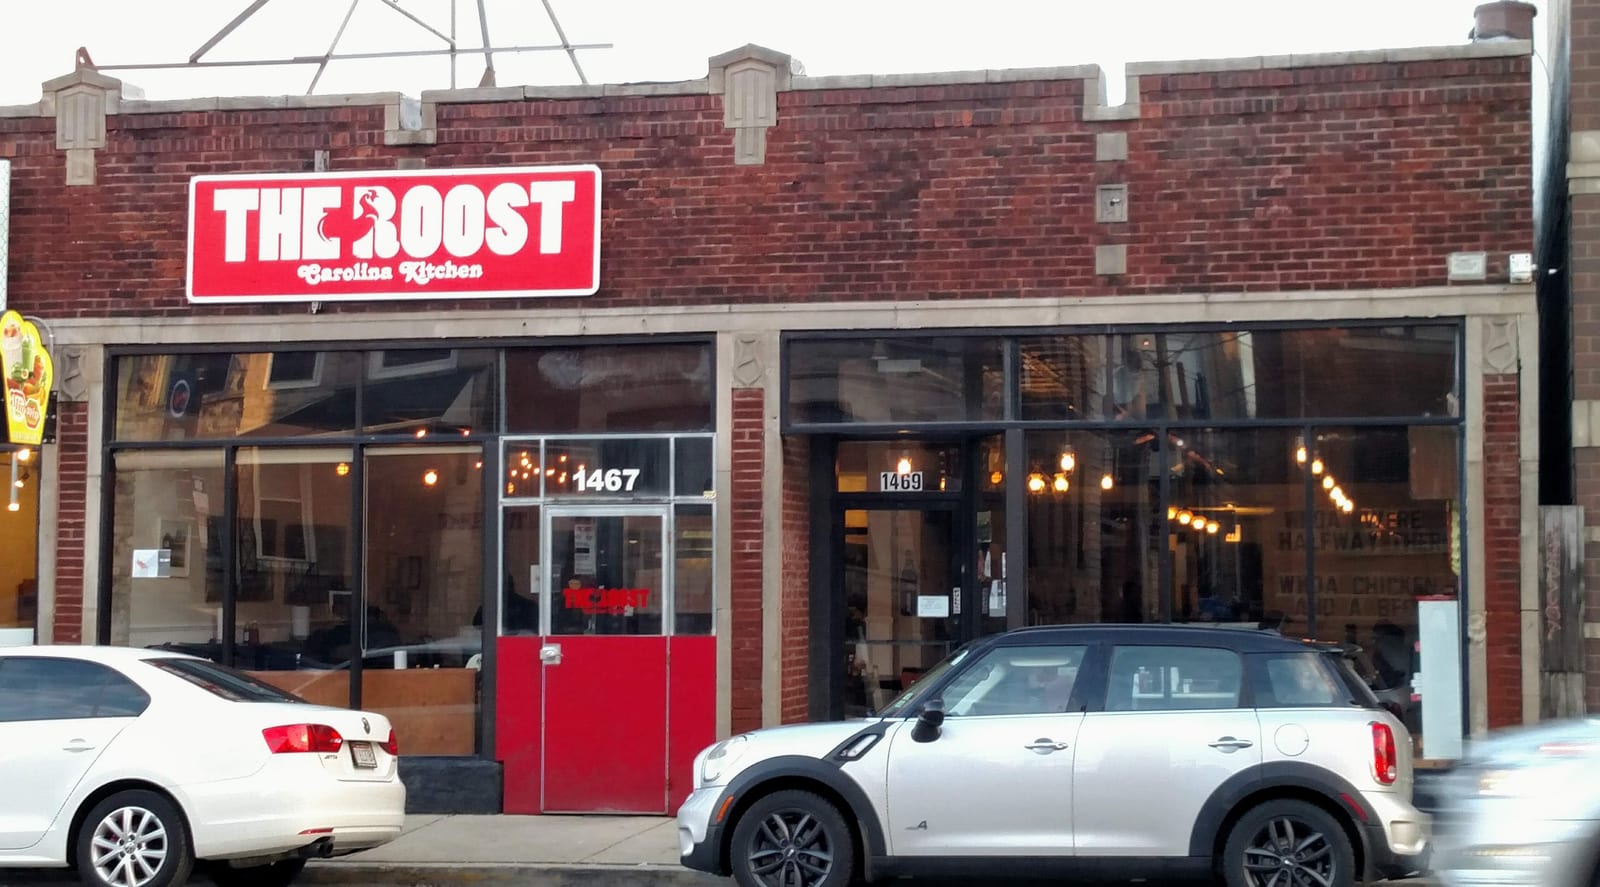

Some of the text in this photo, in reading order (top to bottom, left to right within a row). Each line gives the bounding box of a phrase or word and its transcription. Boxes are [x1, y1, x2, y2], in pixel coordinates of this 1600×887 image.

[213, 180, 576, 263] THE ROOST
[297, 260, 483, 285] Carolina Kitchen
[572, 468, 640, 491] 1467
[881, 472, 922, 491] 1469
